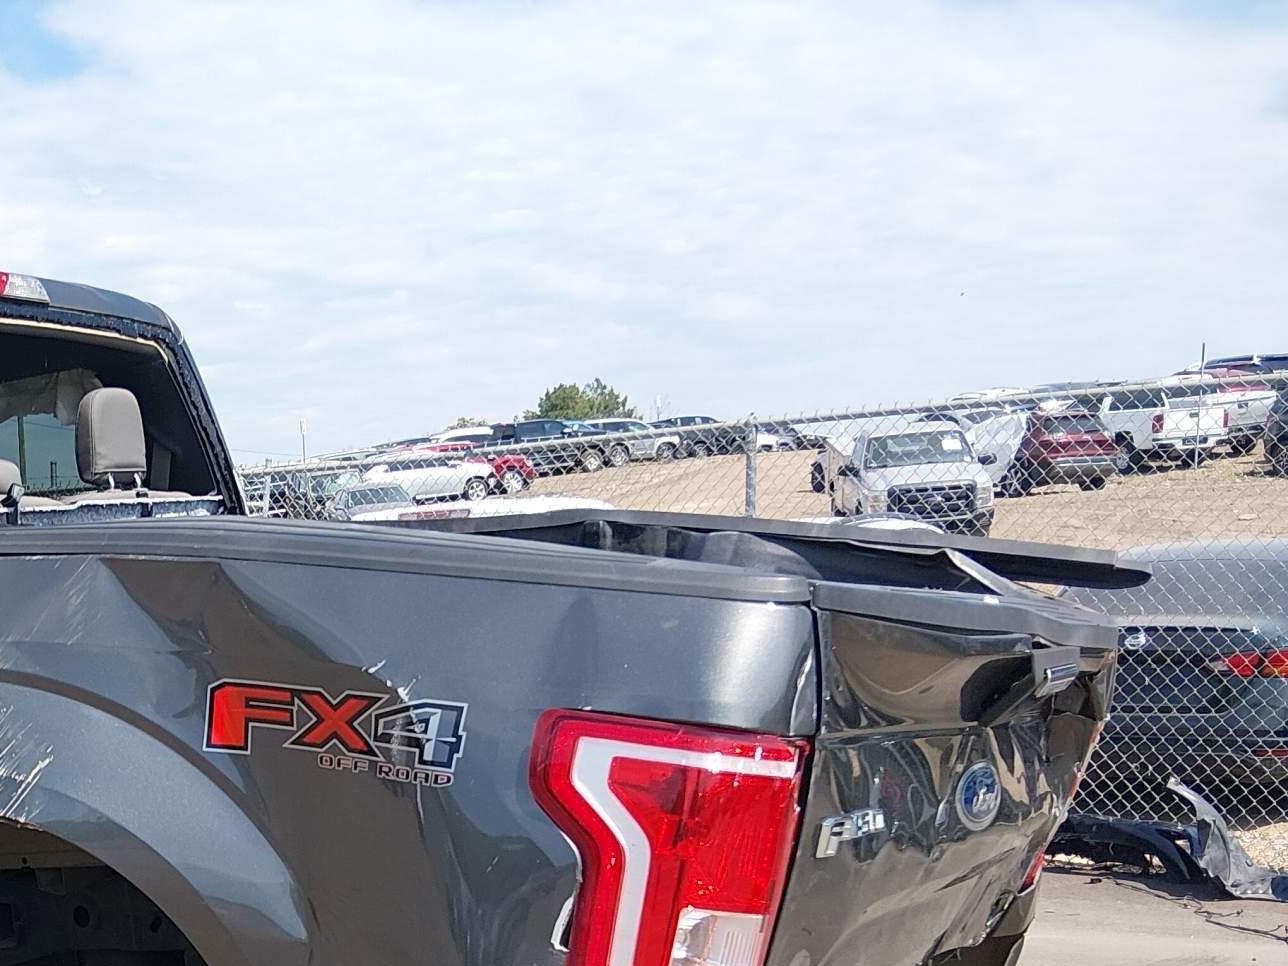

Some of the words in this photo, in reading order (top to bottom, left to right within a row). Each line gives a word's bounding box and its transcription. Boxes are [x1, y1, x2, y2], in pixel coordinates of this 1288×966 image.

[203, 678, 468, 771] FX4
[317, 753, 368, 774] OFF
[376, 764, 454, 788] ROAD
